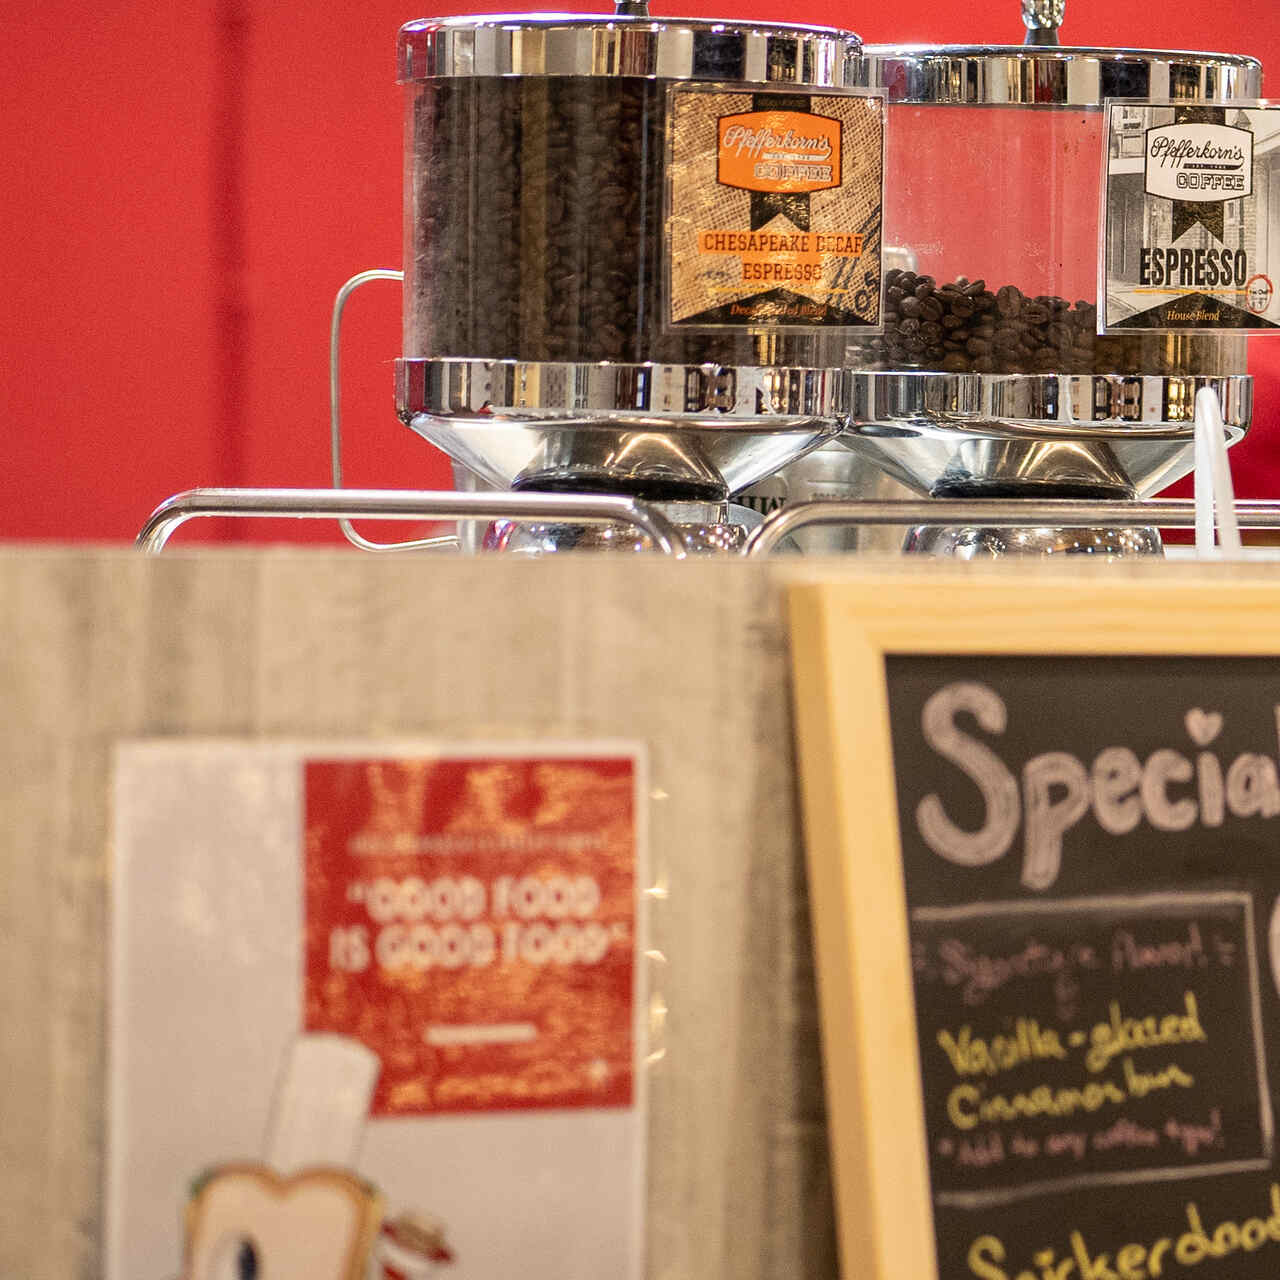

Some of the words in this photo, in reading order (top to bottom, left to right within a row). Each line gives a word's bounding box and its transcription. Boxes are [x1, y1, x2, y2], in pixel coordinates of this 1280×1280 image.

[723, 124, 833, 159] Pfefferkorn's
[1150, 136, 1245, 169] Pfefferkorn's
[1176, 172, 1245, 191] COFFEE
[704, 233, 809, 253] CHESAPEAKE
[815, 233, 864, 254] DECAF
[743, 262, 823, 281] ESPRESSO
[1139, 247, 1248, 287] ESPRESSO
[1167, 309, 1195, 321] House
[1196, 309, 1221, 321] Blend
